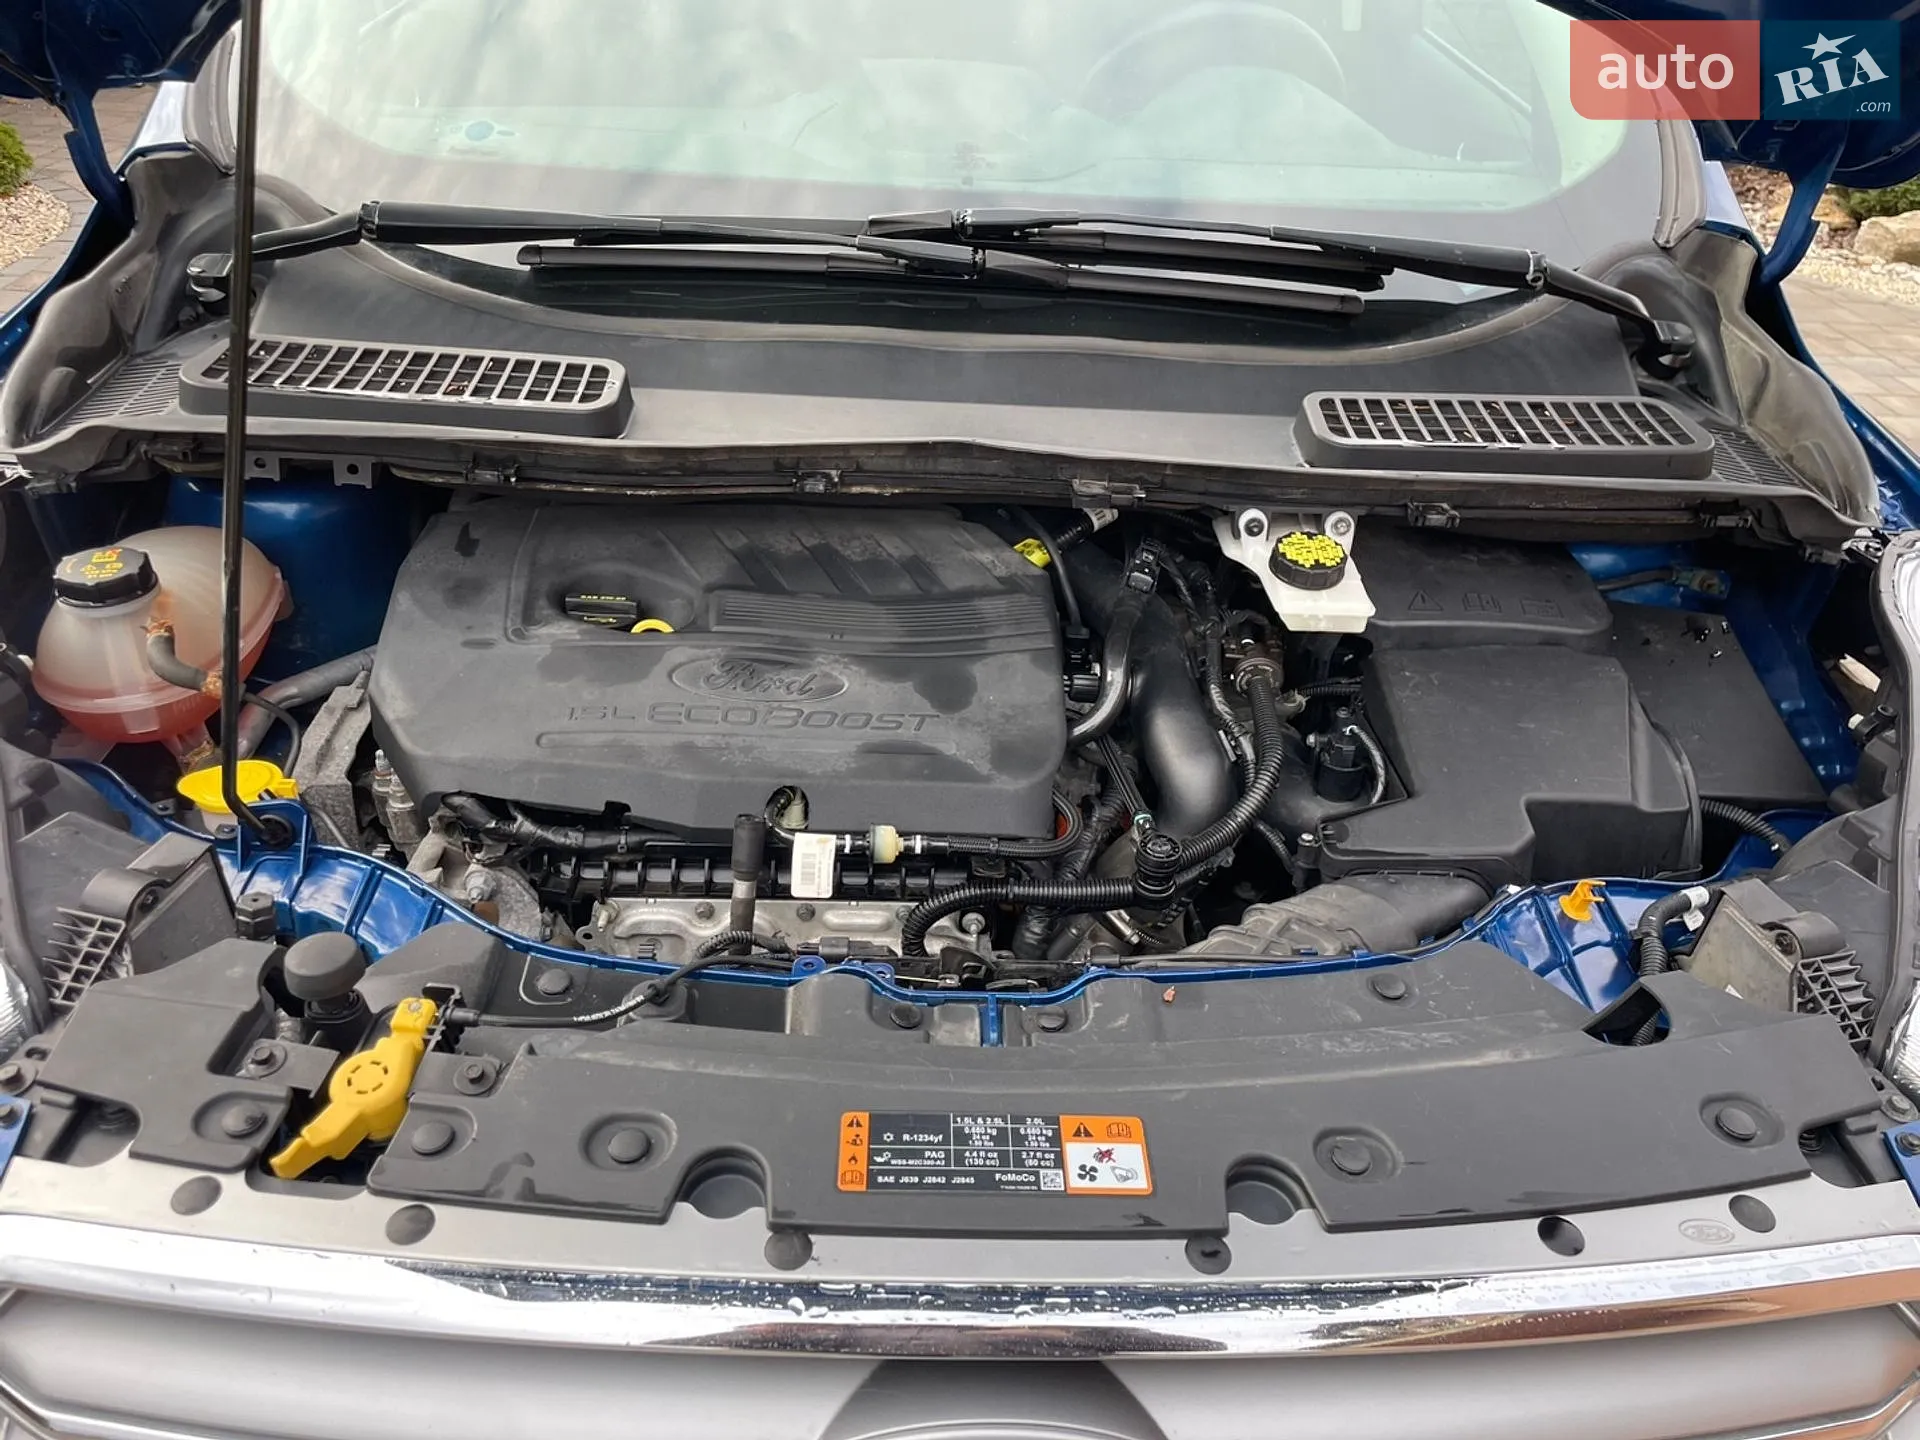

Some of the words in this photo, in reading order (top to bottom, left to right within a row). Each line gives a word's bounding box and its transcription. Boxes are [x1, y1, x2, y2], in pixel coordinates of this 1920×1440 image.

[702, 660, 818, 697] Ford
[647, 702, 941, 732] ECOBOOST
[902, 1133, 944, 1144] R-1234yf
[924, 1151, 945, 1159] PAG
[995, 1173, 1036, 1182] FoMoCo
